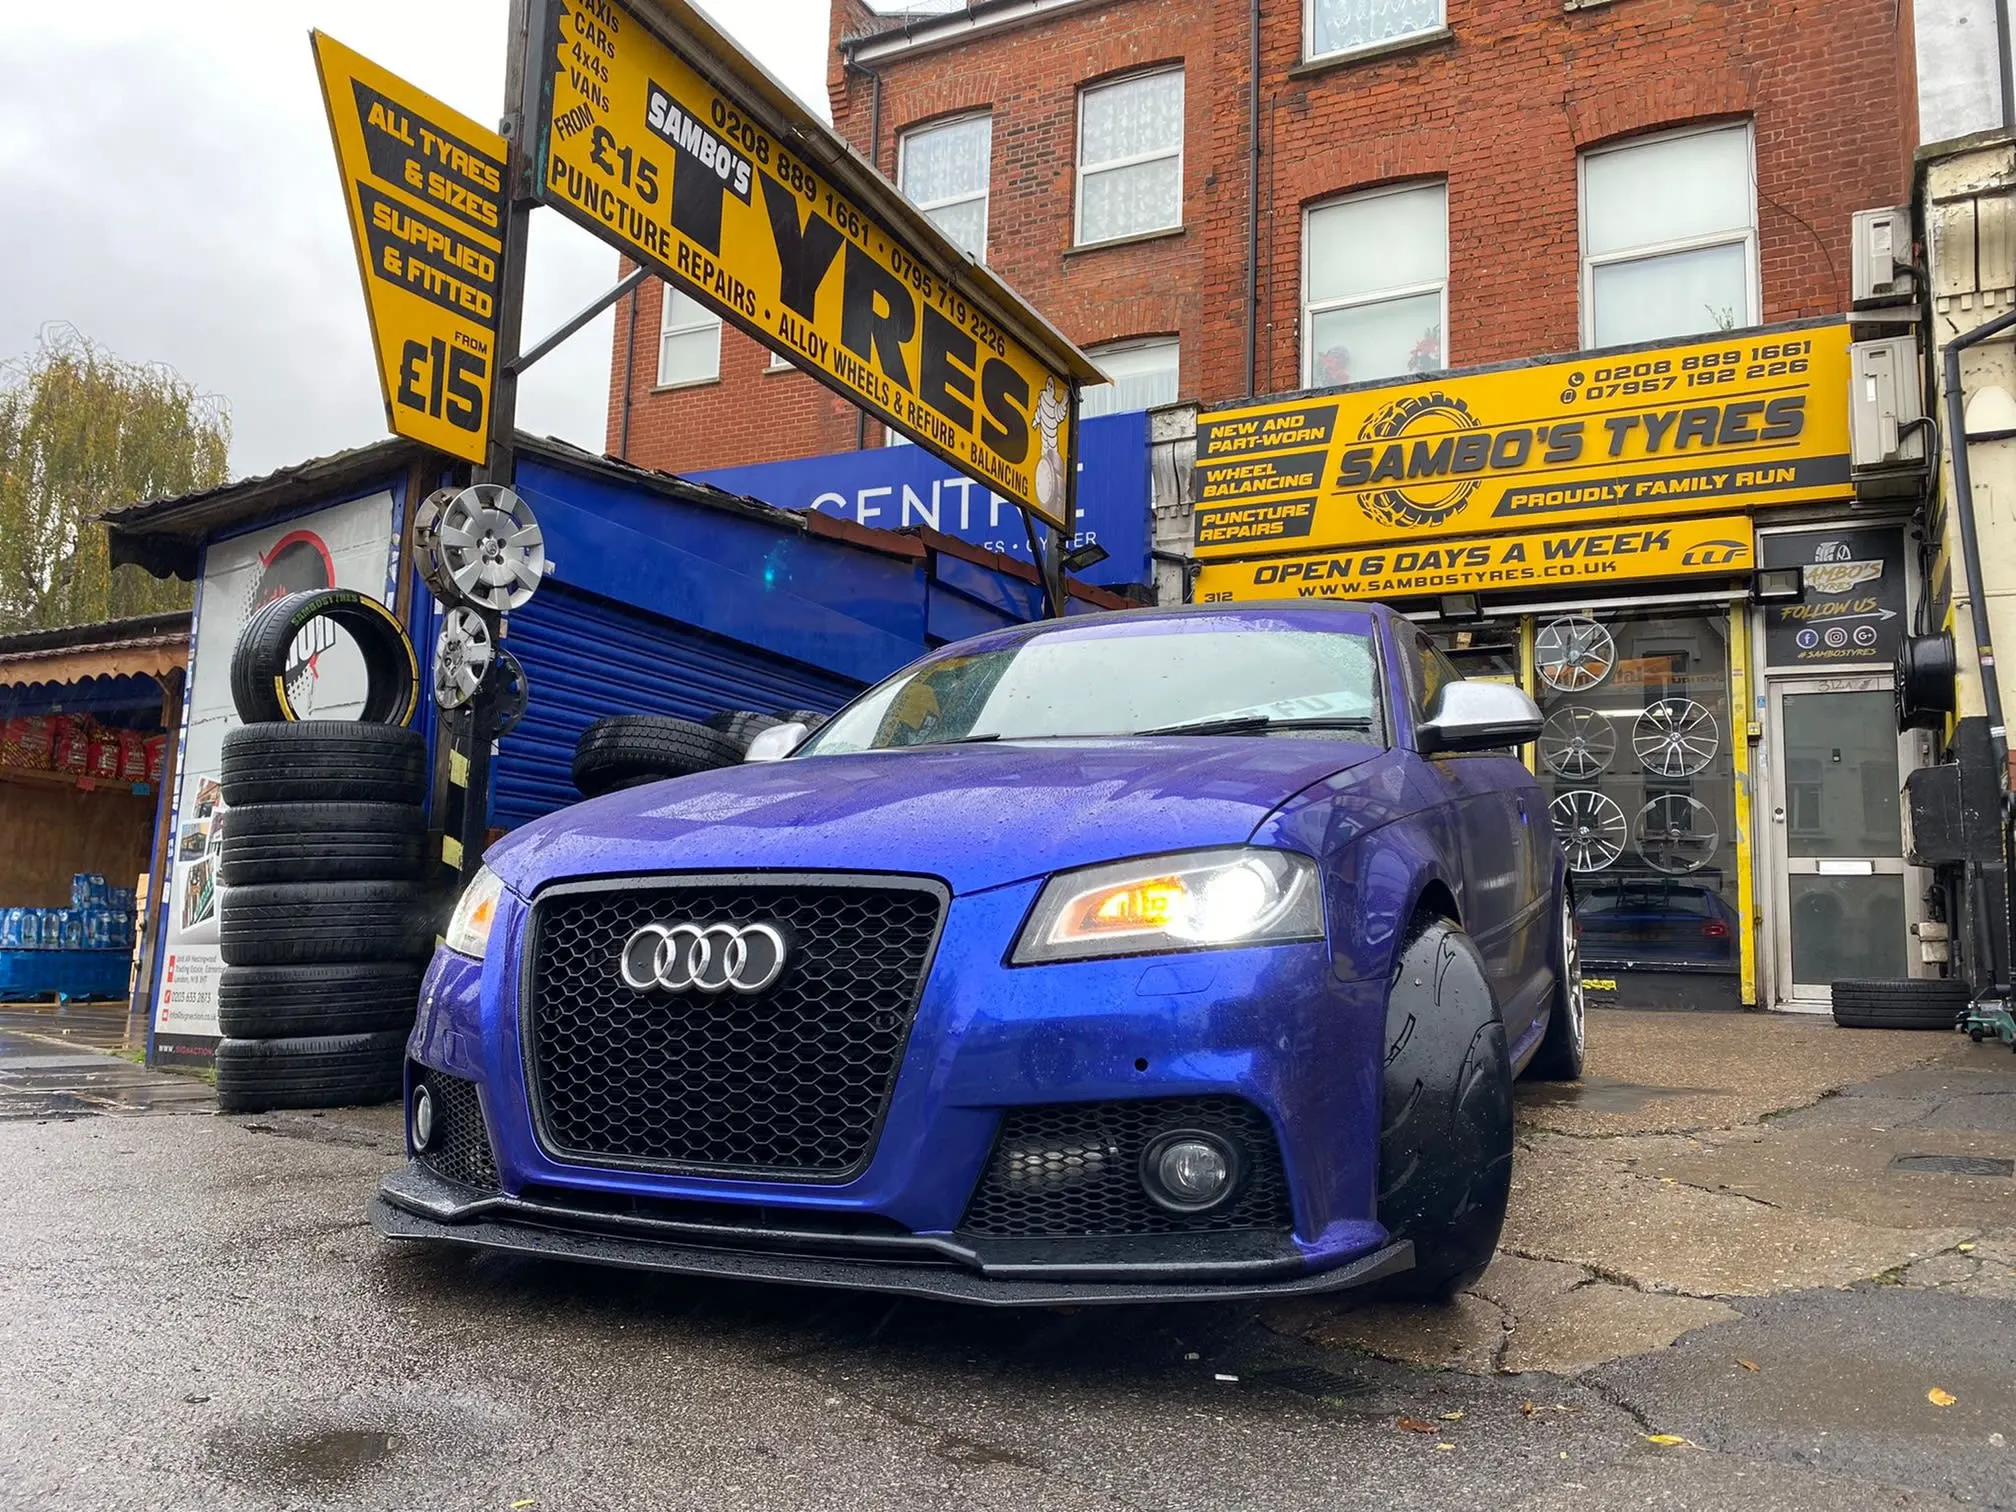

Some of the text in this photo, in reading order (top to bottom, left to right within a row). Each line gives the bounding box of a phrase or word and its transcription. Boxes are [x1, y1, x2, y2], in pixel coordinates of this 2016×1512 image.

[554, 101, 595, 141] FROM
[368, 102, 501, 193] ALL TYRES
[649, 91, 751, 195] SAMBO'S
[590, 125, 659, 205] £15
[405, 158, 498, 228] & SIZES
[373, 201, 495, 283] SUPPLIED
[711, 98, 1005, 358] 0208 889 1661 0795 719 2226
[384, 246, 493, 319] & FITTED
[645, 77, 1030, 465] TYRES
[455, 331, 487, 354] FROM
[551, 153, 1029, 497] PUNCTURE REPAIRS ALLOY WHEELS & REFURB BALANCING
[1586, 359, 1809, 401] 07957 192 226
[1594, 340, 1812, 383] 0208 889 1661
[398, 336, 486, 433] £15
[1208, 427, 1325, 453] PART-WORN
[1210, 415, 1305, 439] NEW AND
[1336, 396, 1806, 487] SAMBO'S TYRES
[1203, 474, 1313, 498] BALANCING
[1206, 463, 1277, 483] WHEEL
[1511, 467, 1796, 509] PROUDLY FAMILY RUN
[1200, 521, 1284, 542] REPAIRS
[1202, 503, 1310, 527] PUNCTURE
[1254, 529, 1672, 585] OPEN 6 DAYS A WEEK
[1807, 562, 1881, 584] AMBO'S
[1204, 591, 1233, 603] 312
[1298, 561, 1616, 597] WWW.SAMBOSTYRES.CO.UK
[1781, 597, 1877, 621] FOLLOW US
[1798, 648, 1876, 659] #SAMBOSTYRES
